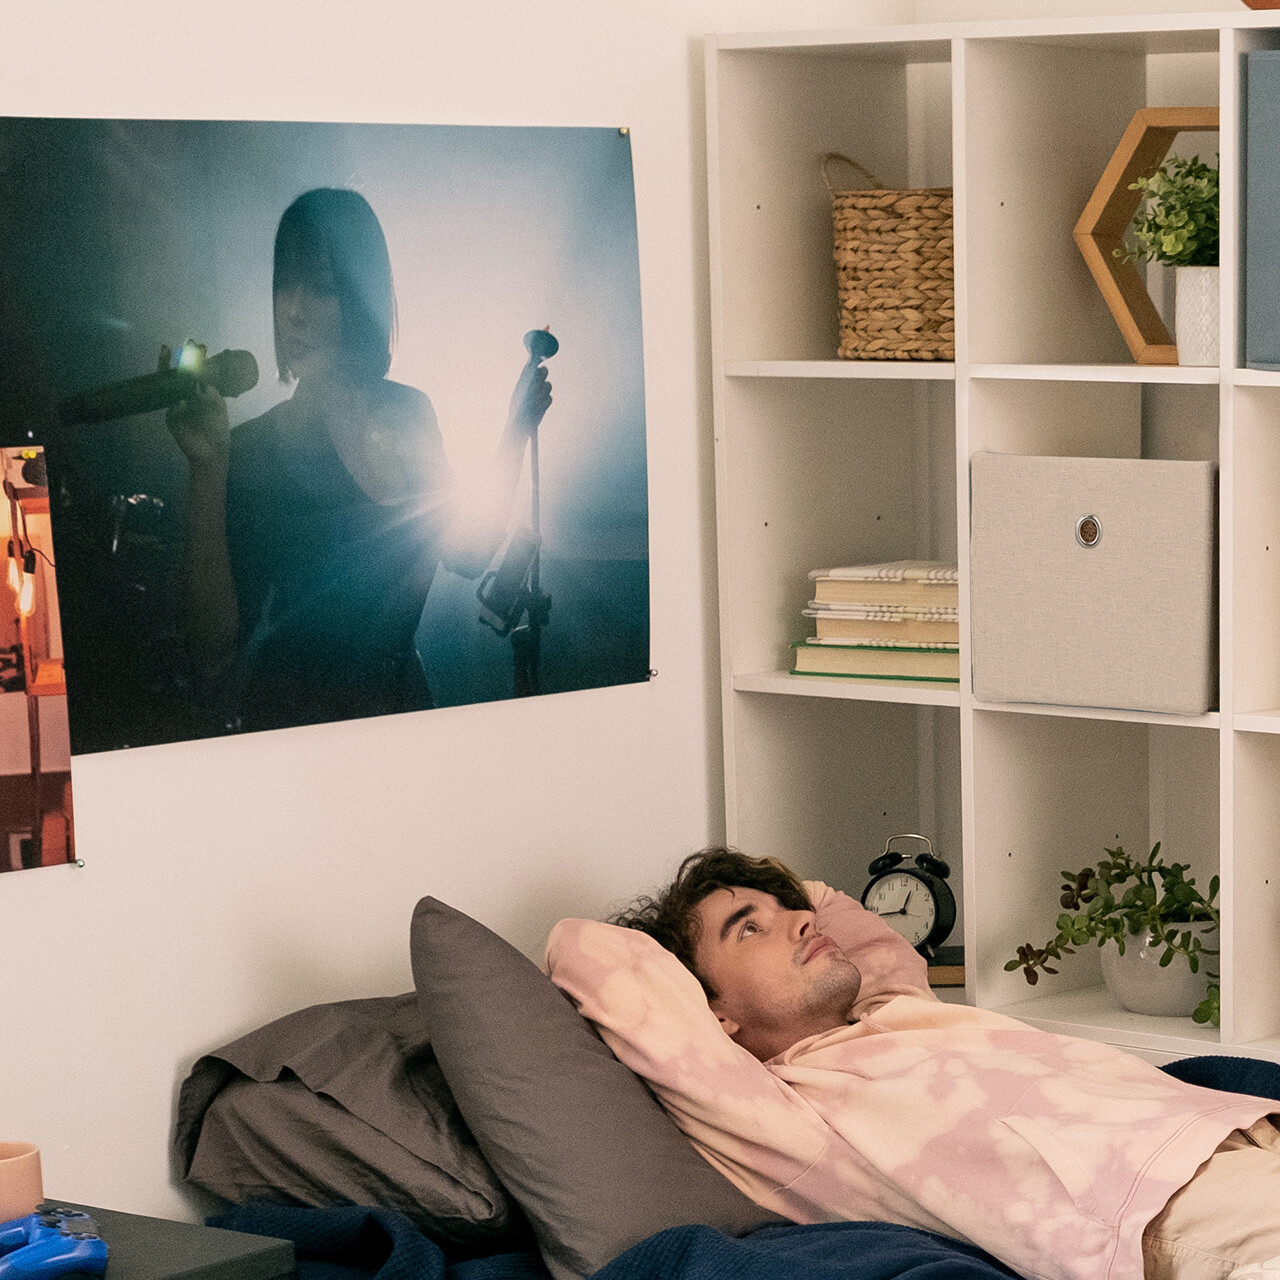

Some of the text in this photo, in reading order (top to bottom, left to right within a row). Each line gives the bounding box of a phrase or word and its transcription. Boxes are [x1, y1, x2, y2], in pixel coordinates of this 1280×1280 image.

[888, 883, 894, 891] 11
[900, 879, 909, 887] 12
[915, 883, 919, 891] 1
[879, 893, 885, 901] 10
[924, 893, 930, 902] 2
[929, 908, 934, 916] 3
[924, 922, 929, 930] 4
[914, 932, 920, 940] 5
